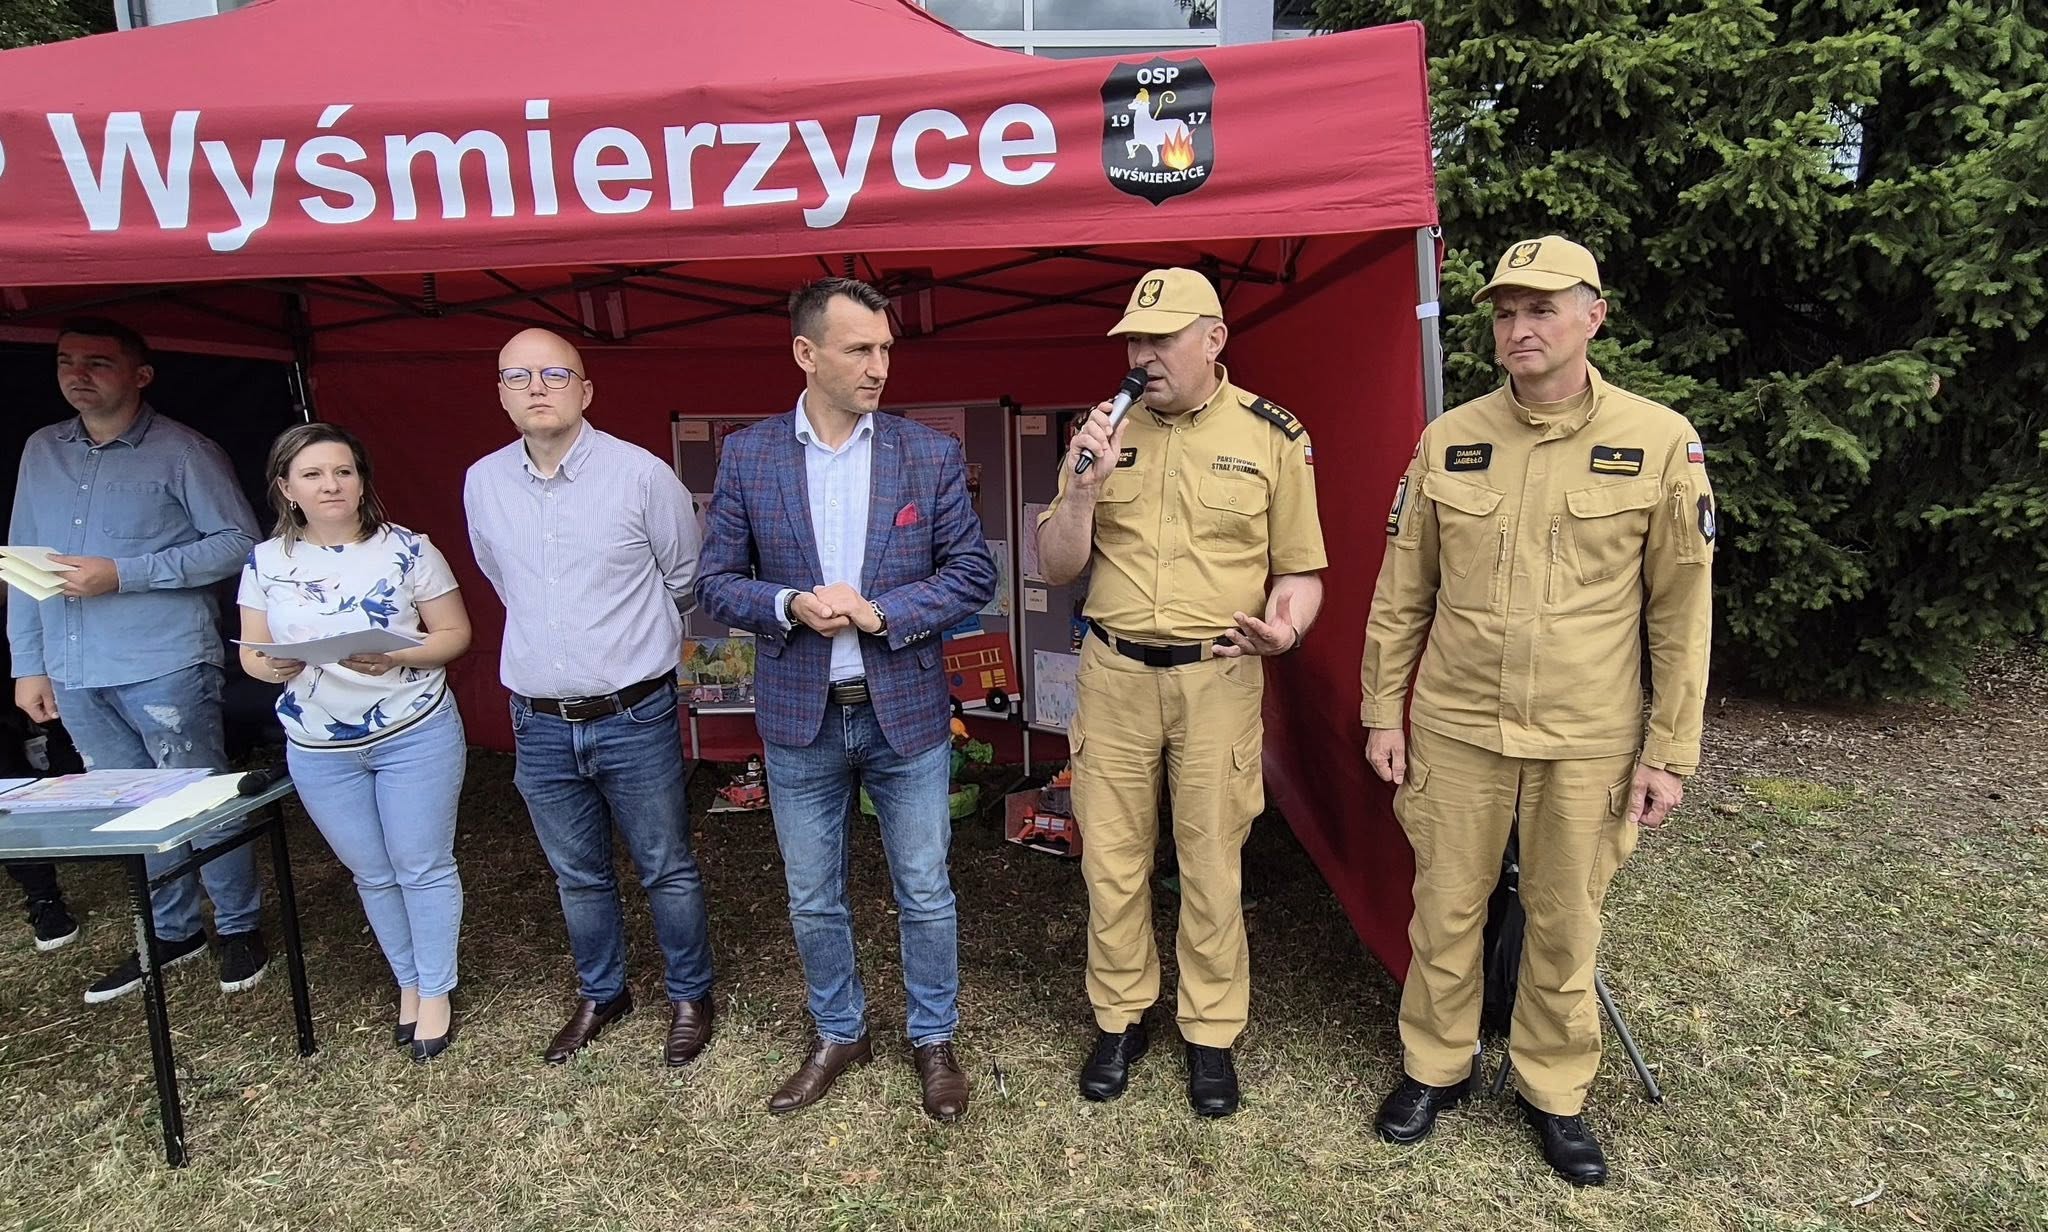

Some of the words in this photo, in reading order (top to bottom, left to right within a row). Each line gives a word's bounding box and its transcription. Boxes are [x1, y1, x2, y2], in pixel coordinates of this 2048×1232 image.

[1136, 66, 1180, 85] OSP
[1111, 114, 1130, 127] 19
[1188, 112, 1207, 125] 17
[46, 99, 1058, 252] Wyśmierzyce
[1109, 165, 1205, 184] WYŚMIERZYCE
